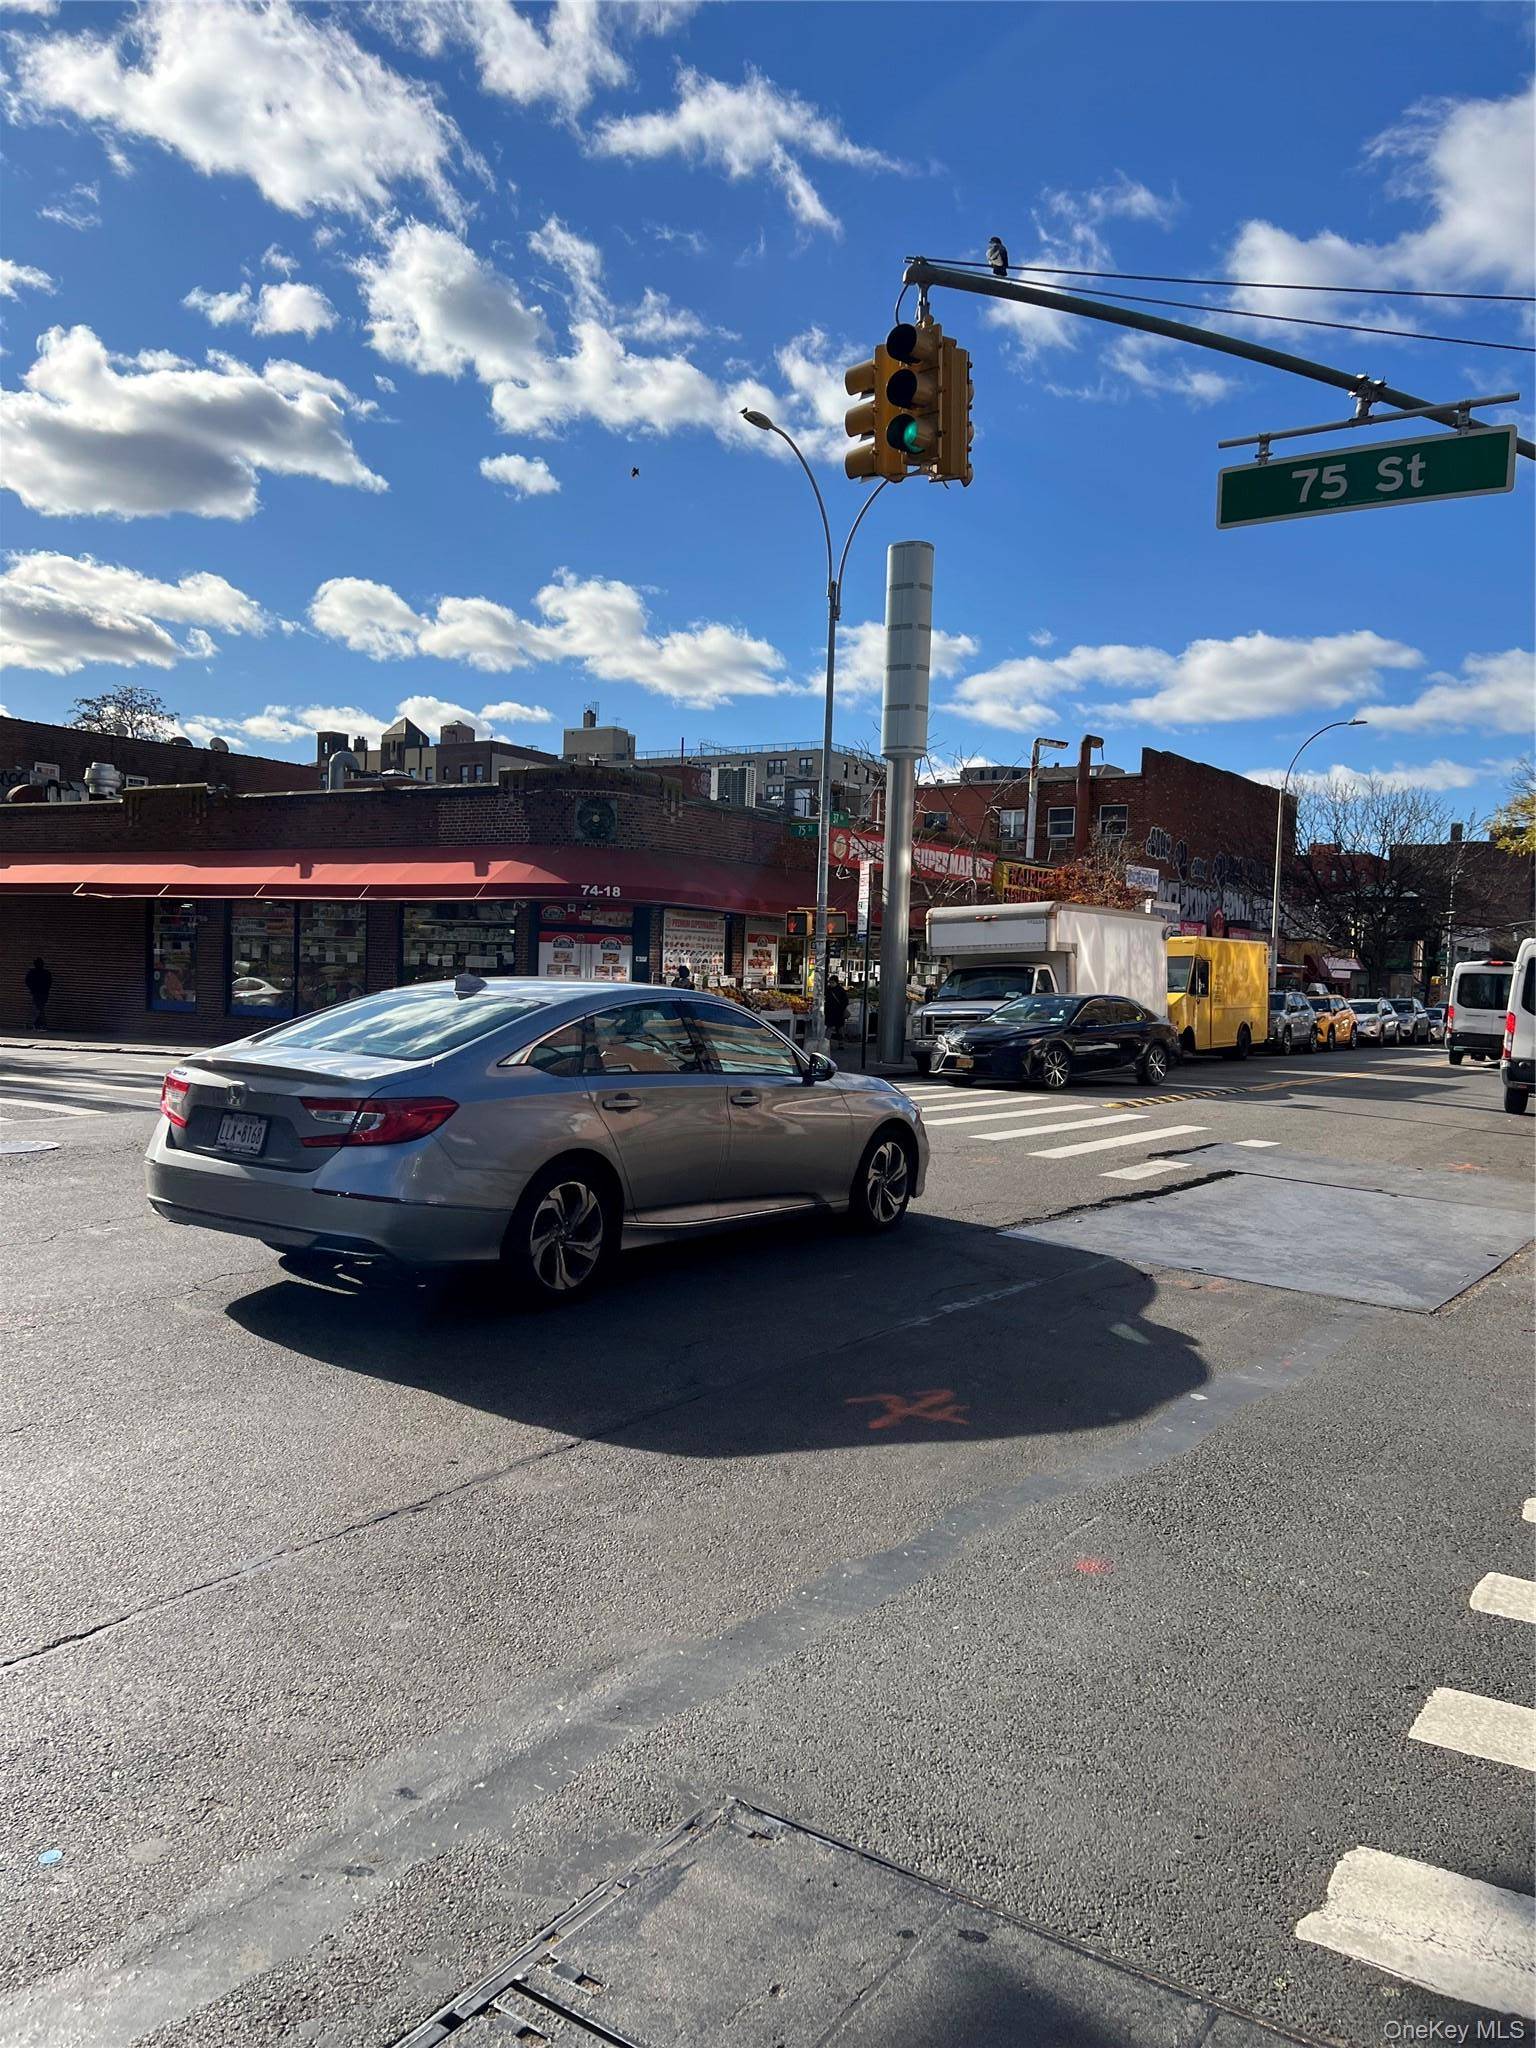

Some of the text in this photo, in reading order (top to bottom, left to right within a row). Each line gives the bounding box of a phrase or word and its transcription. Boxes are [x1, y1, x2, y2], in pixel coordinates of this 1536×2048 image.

[1291, 453, 1426, 503] 75 St
[798, 825, 806, 836] 75
[581, 884, 621, 897] 74-18
